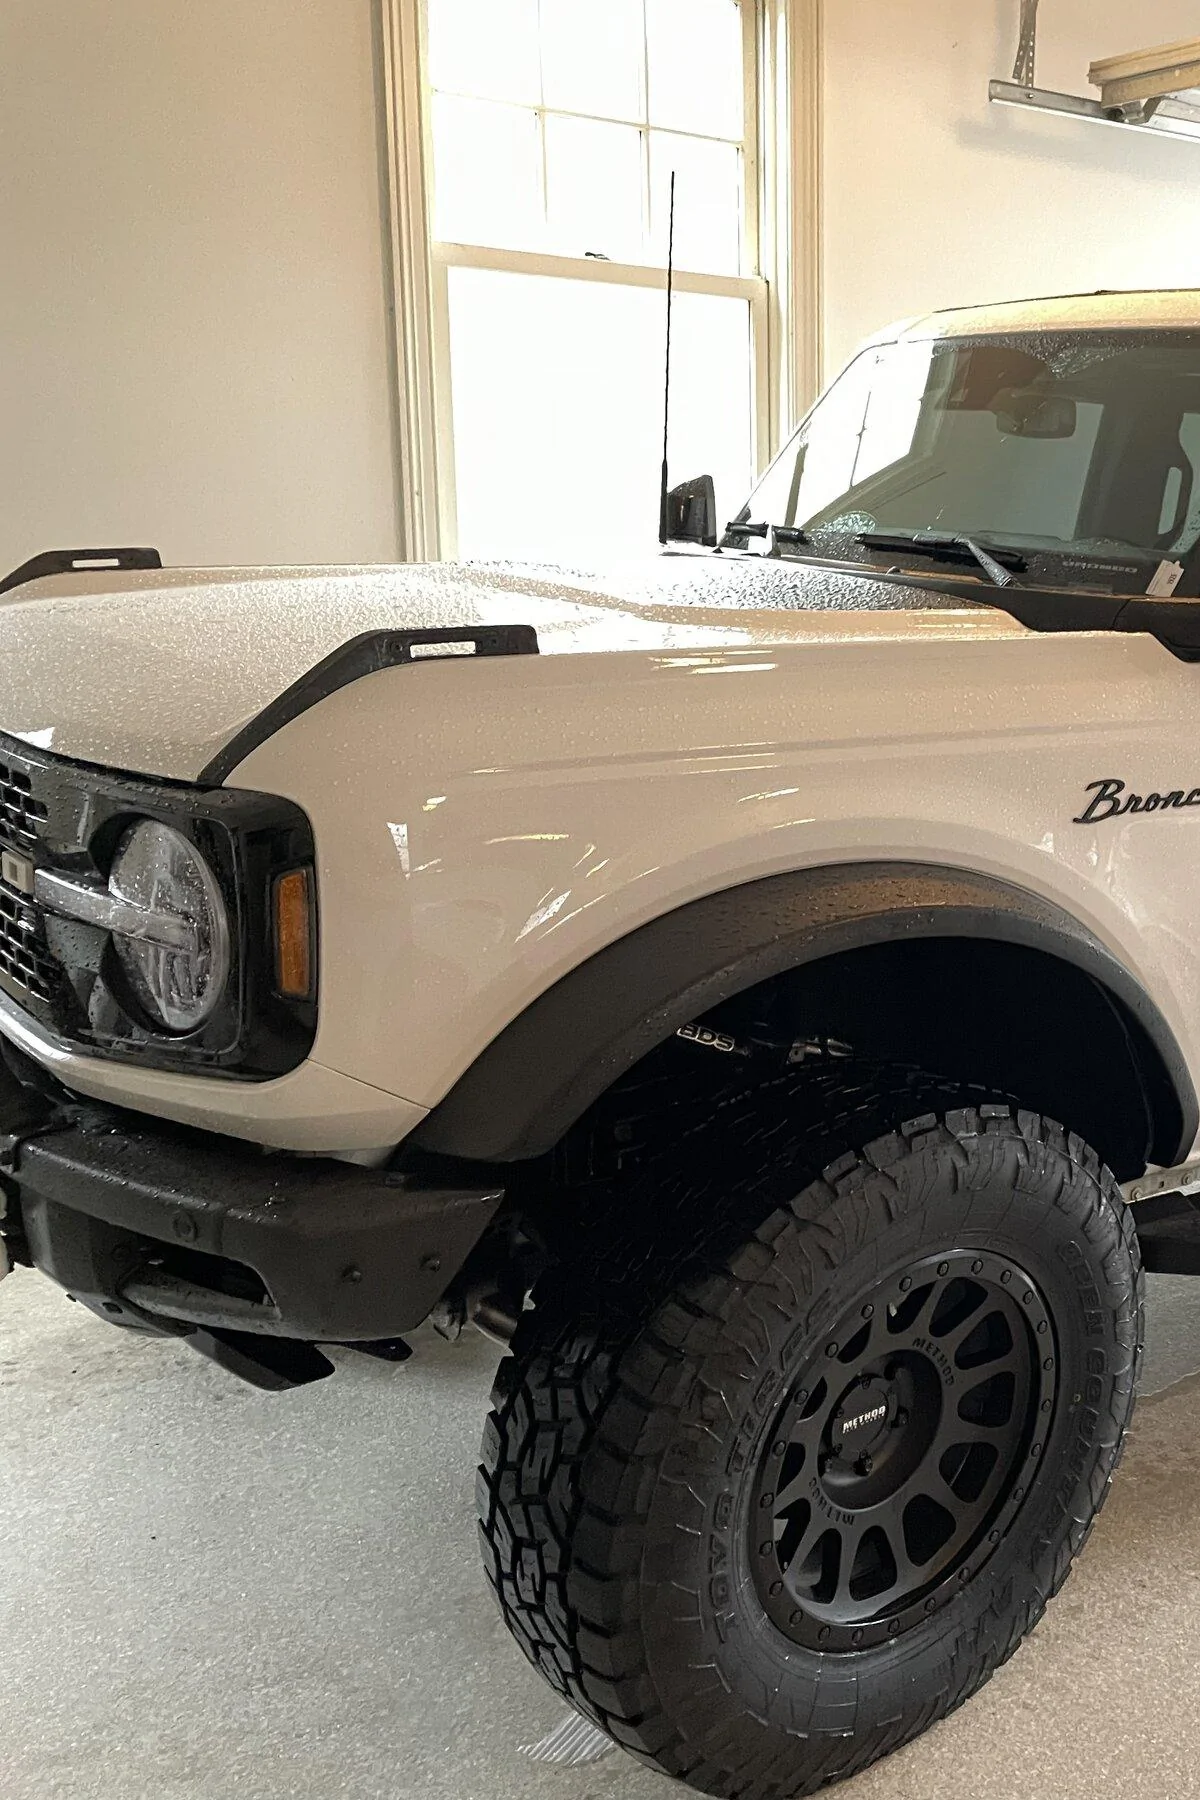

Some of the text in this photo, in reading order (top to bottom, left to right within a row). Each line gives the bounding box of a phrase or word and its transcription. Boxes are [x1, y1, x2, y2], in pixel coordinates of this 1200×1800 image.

[676, 1023, 736, 1053] BDS
[912, 1337, 954, 1386] METHOD
[842, 1405, 886, 1432] METHOD
[809, 1477, 856, 1526] METHOD
